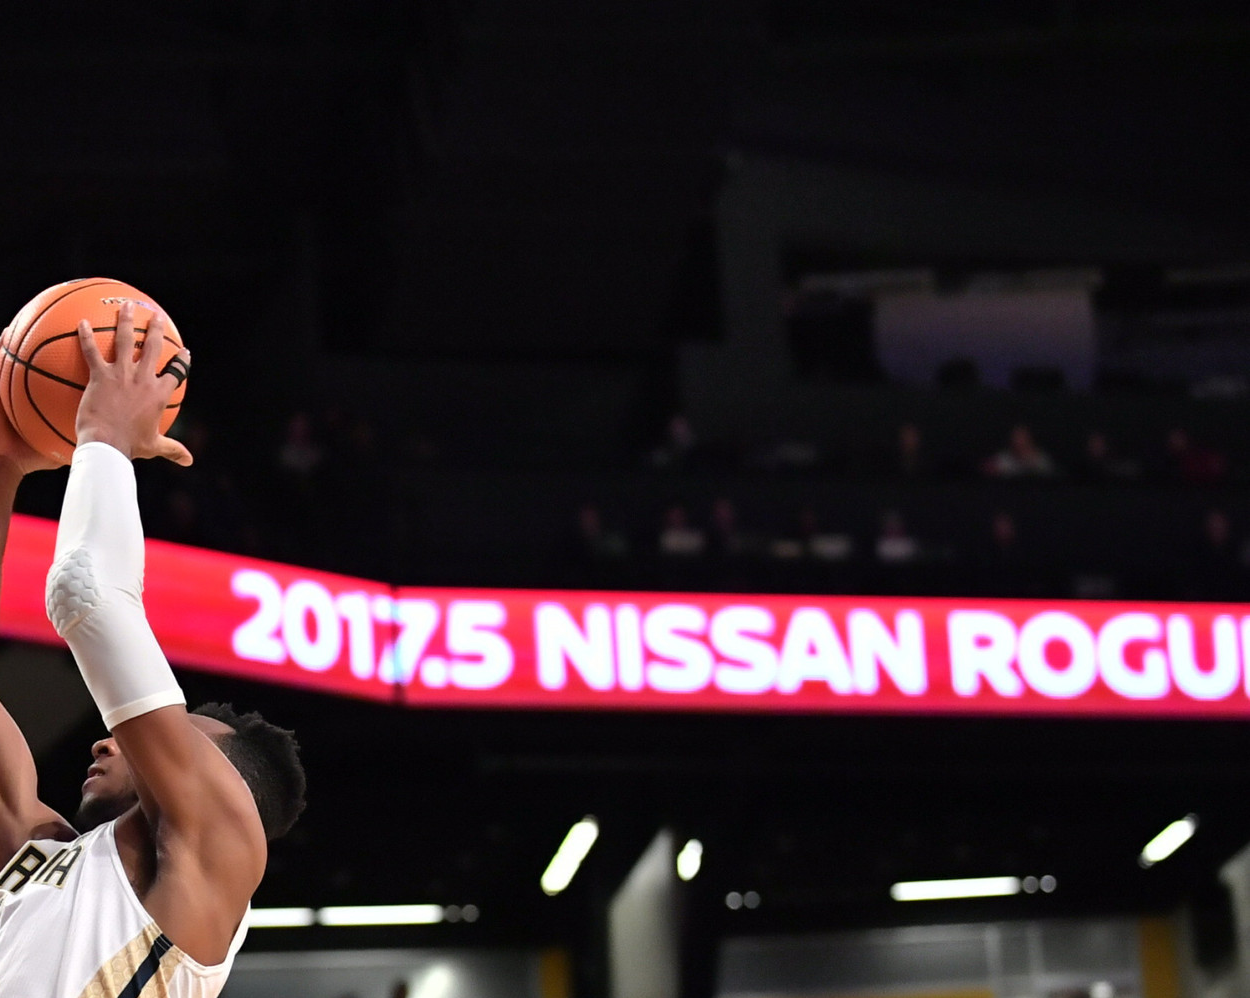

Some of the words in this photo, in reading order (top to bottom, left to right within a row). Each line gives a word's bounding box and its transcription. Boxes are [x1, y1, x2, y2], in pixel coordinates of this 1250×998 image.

[230, 568, 515, 690] 2017.5
[534, 602, 928, 696] NISSAN
[947, 609, 1250, 701] ROGU
